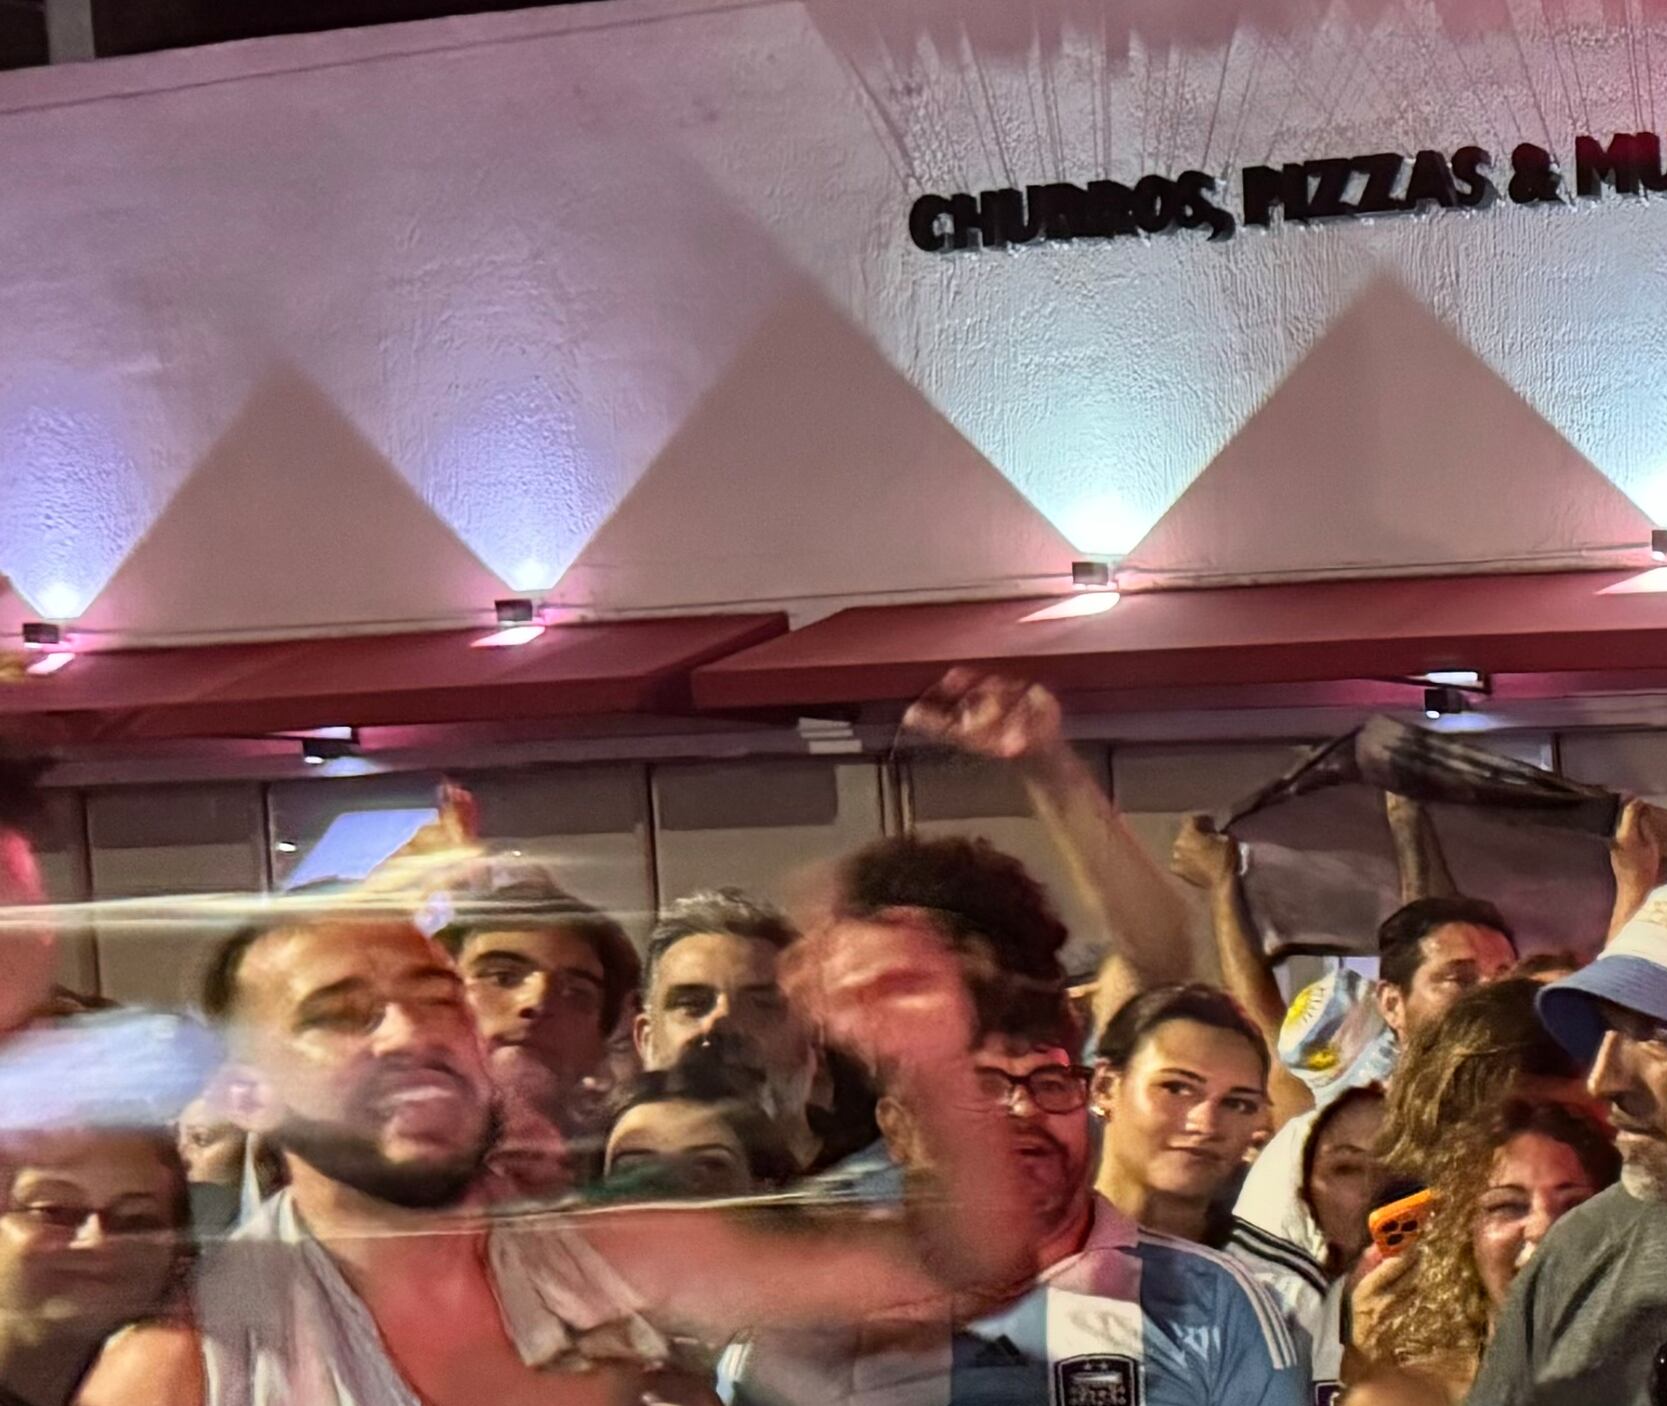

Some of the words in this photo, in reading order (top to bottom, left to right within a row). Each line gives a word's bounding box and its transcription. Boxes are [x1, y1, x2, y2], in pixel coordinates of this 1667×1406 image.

[909, 168, 1236, 252] CHURROS,
[1242, 143, 1498, 226] PIZZAS
[1508, 142, 1576, 206] &
